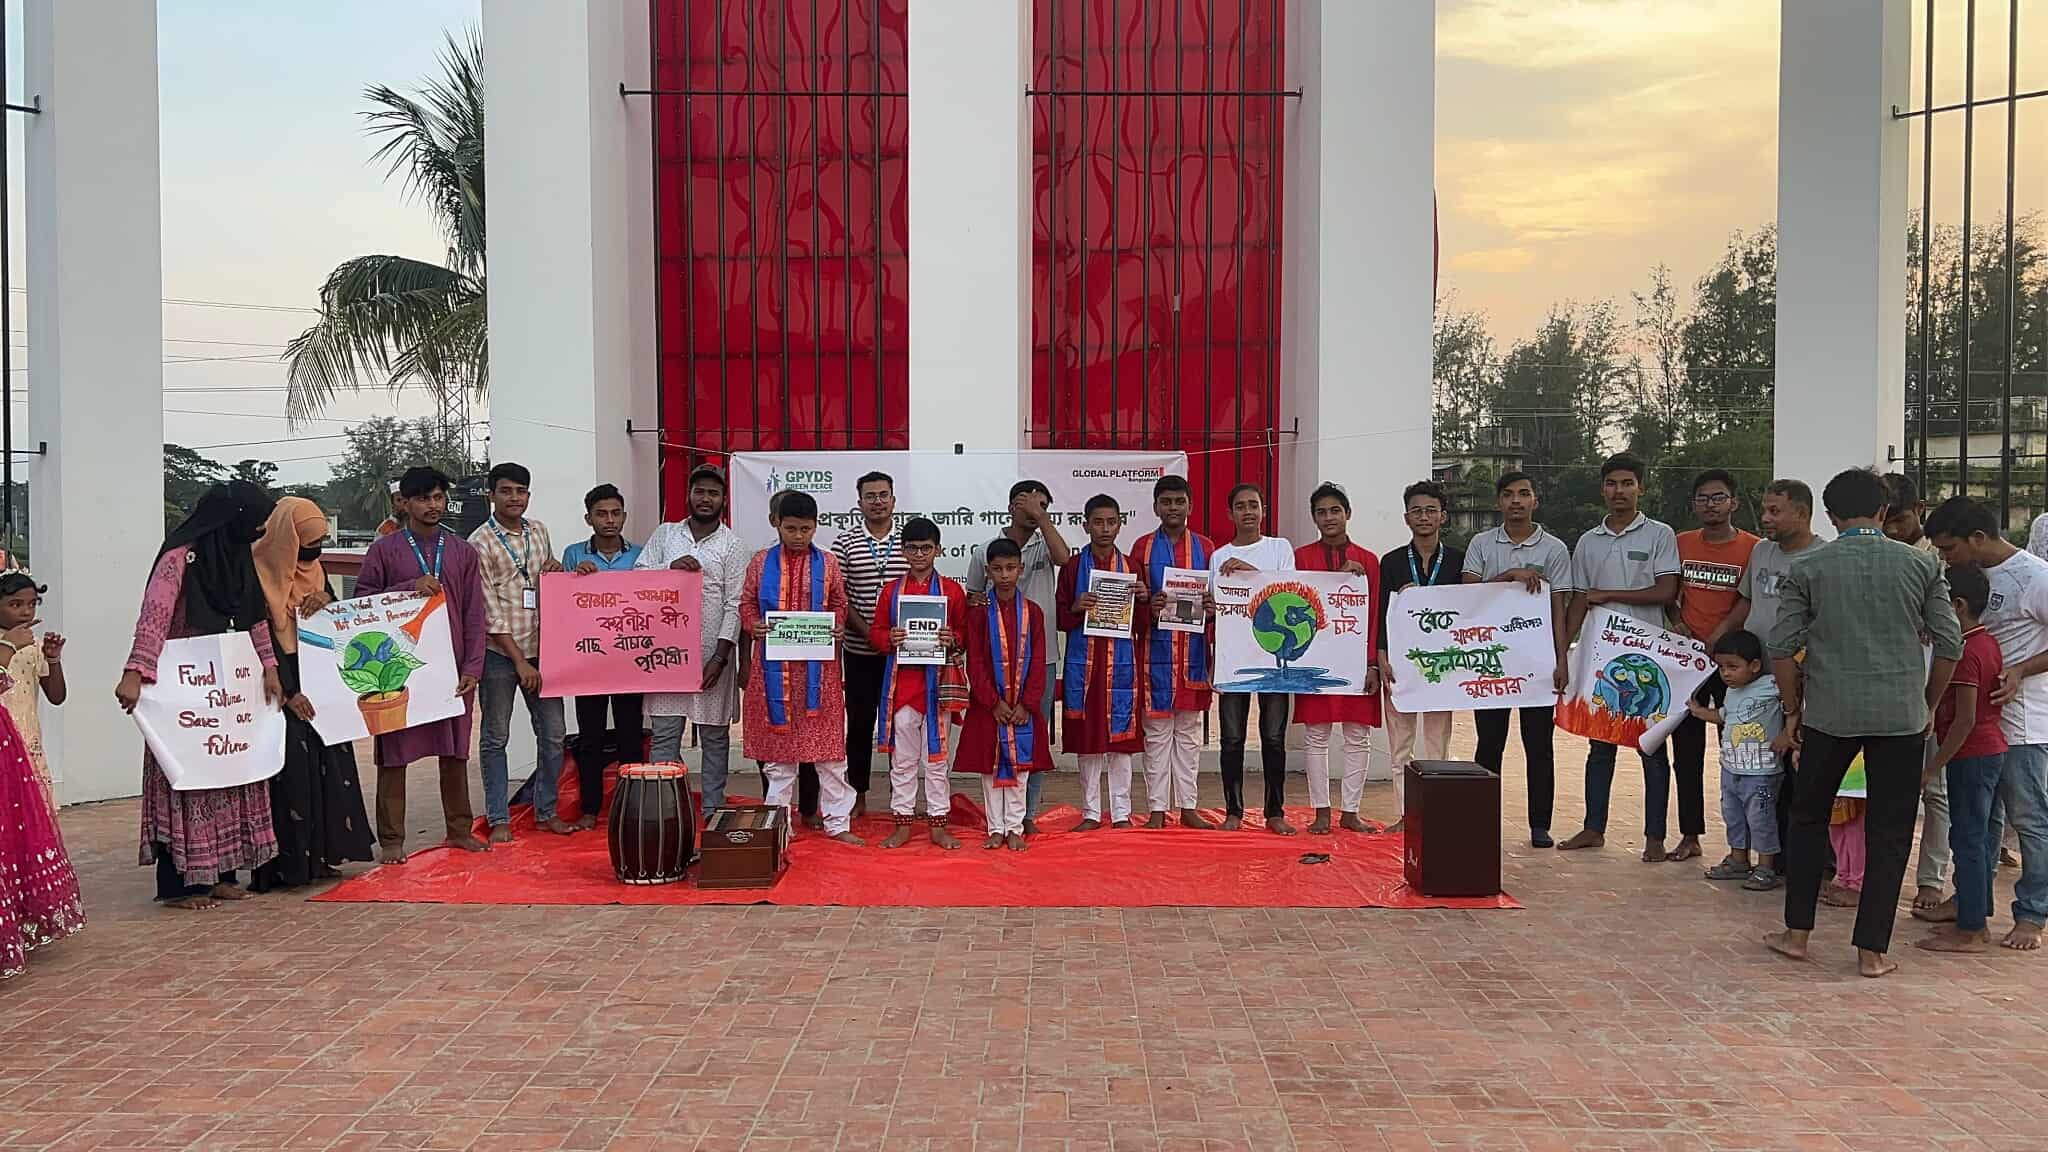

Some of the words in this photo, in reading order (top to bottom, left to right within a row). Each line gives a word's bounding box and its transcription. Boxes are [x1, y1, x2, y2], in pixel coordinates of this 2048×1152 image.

[785, 471, 833, 482] GPYDS
[1072, 469, 1108, 478] GLOBAL
[1110, 469, 1159, 478] PLATFORM
[951, 544, 967, 557] of
[909, 620, 938, 631] END
[779, 630, 799, 639] NOT
[1601, 629, 1620, 646] Stop
[575, 637, 608, 656] গাছ
[178, 661, 216, 686] Fund
[178, 711, 220, 728] Save
